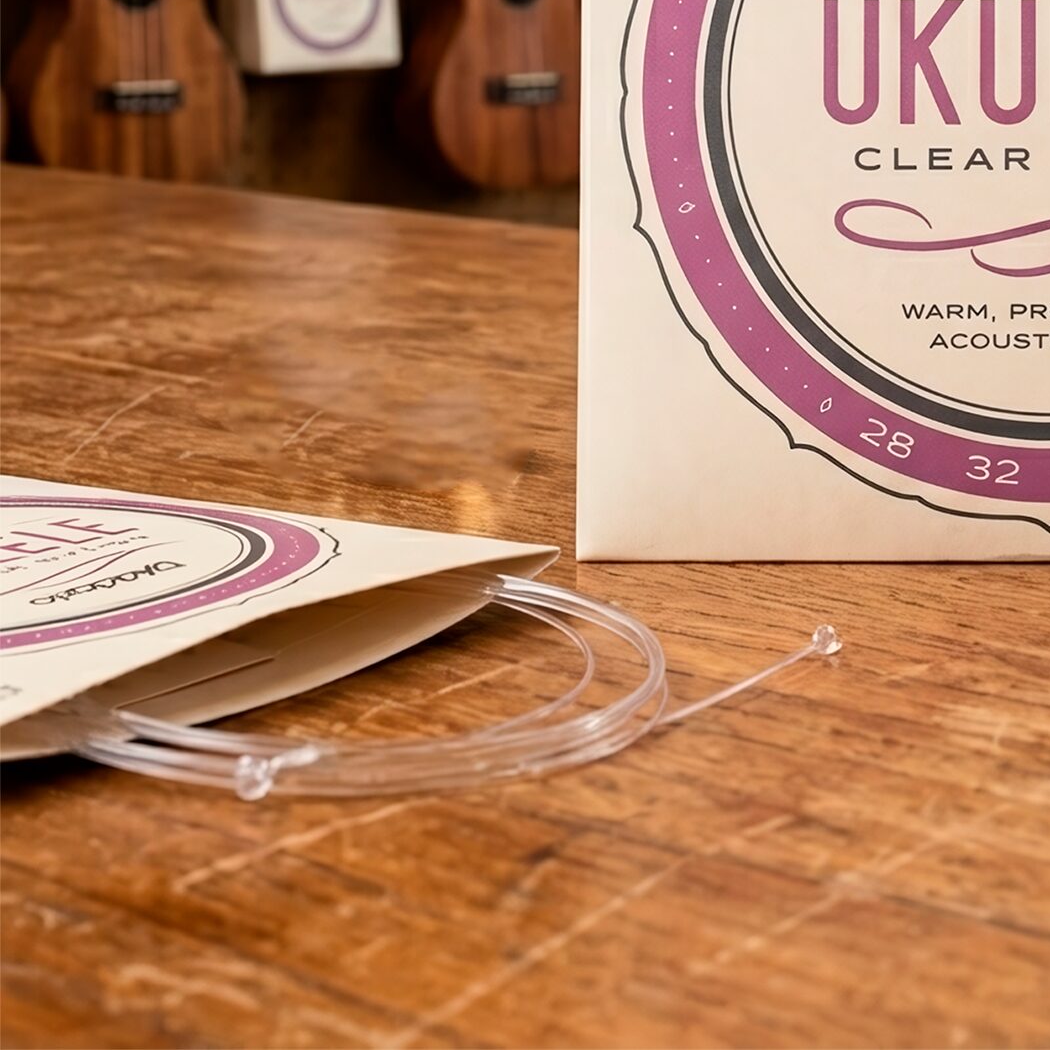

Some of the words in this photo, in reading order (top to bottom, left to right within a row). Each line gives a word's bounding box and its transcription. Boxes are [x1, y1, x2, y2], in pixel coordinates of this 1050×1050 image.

[853, 146, 1032, 172] CLEAR
[901, 302, 997, 324] WARM,
[859, 417, 916, 459] 28
[965, 454, 1021, 486] 32
